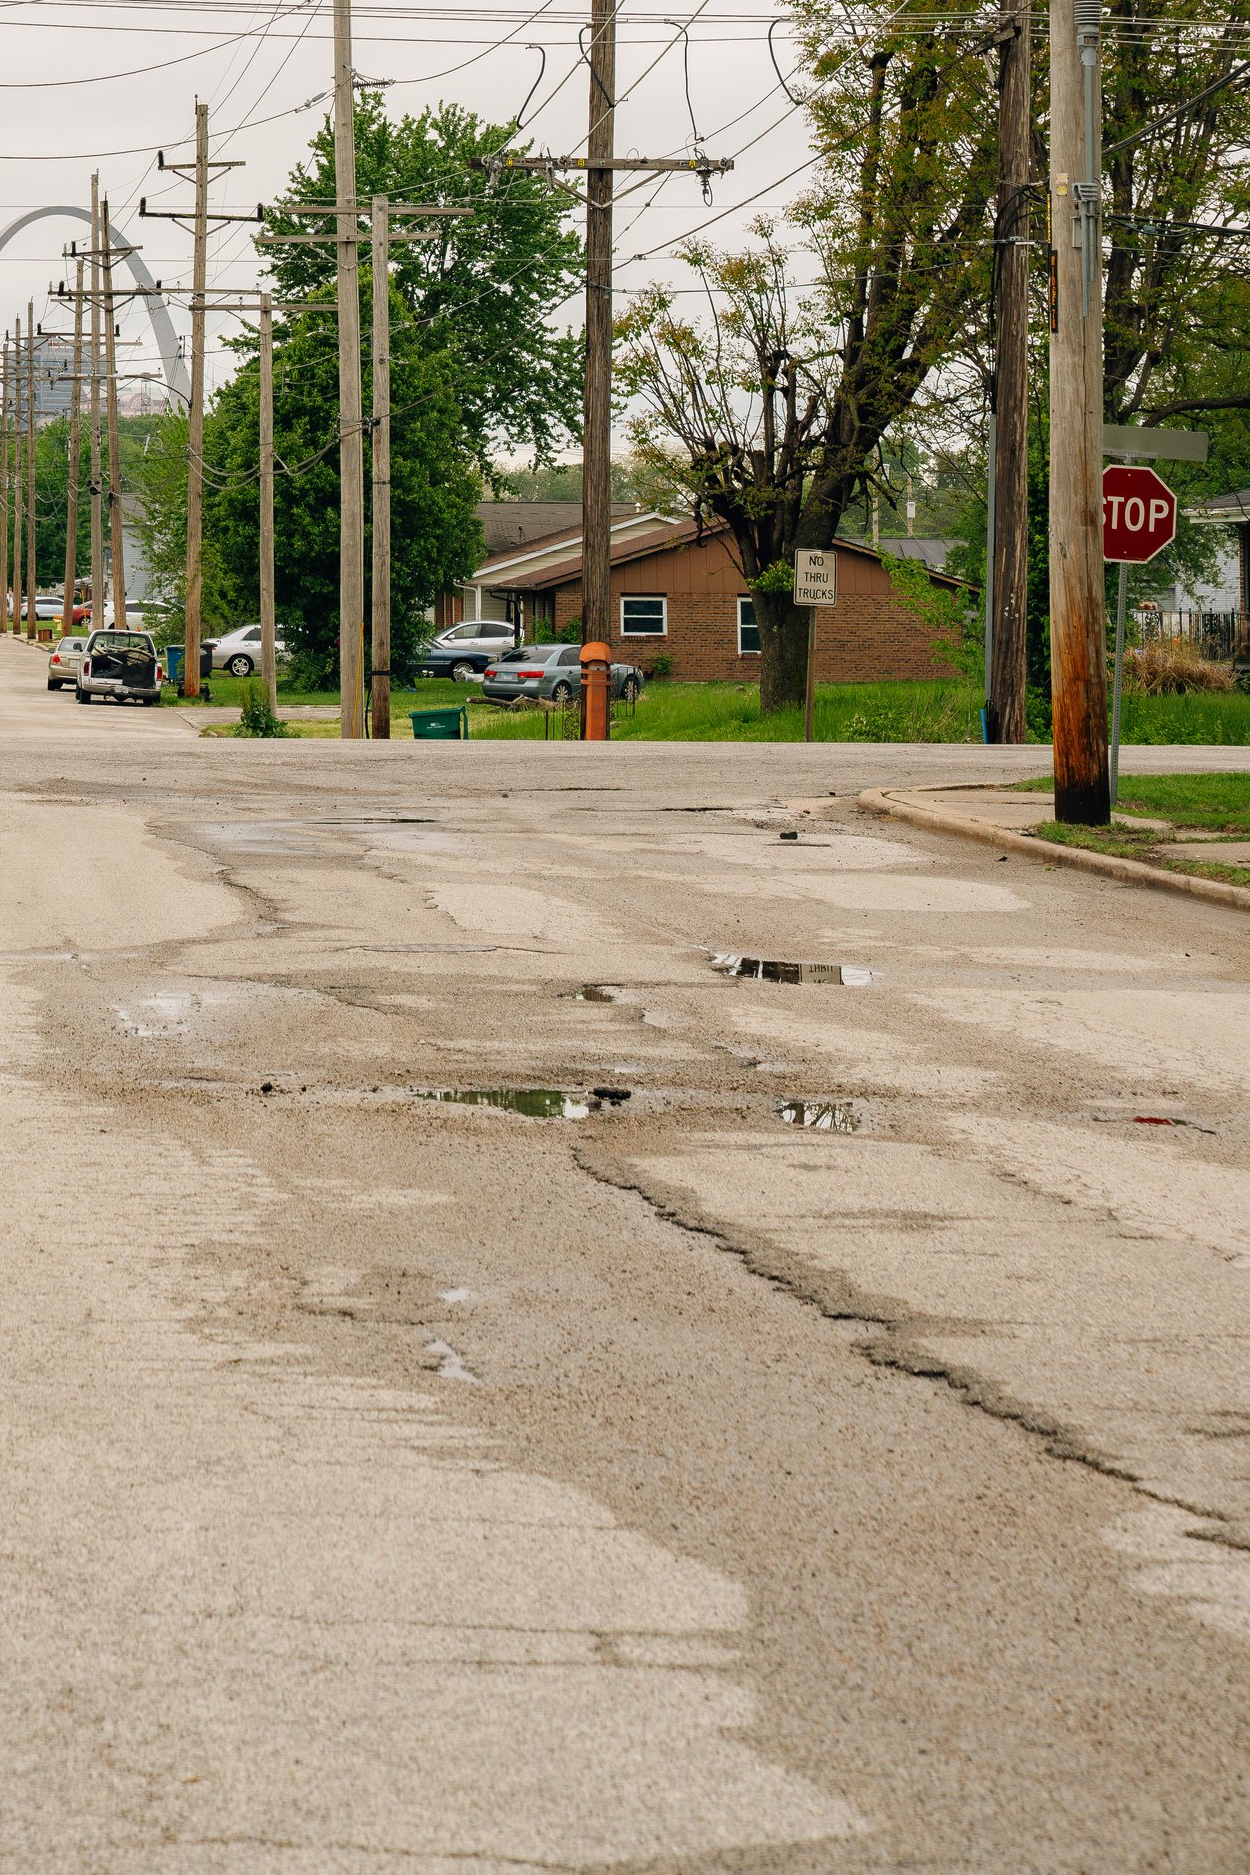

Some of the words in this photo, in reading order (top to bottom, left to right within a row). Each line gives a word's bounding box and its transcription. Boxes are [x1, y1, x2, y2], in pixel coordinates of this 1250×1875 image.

[809, 556, 824, 566] NO
[804, 572, 829, 583] THRU
[798, 587, 834, 600] TRUCKS
